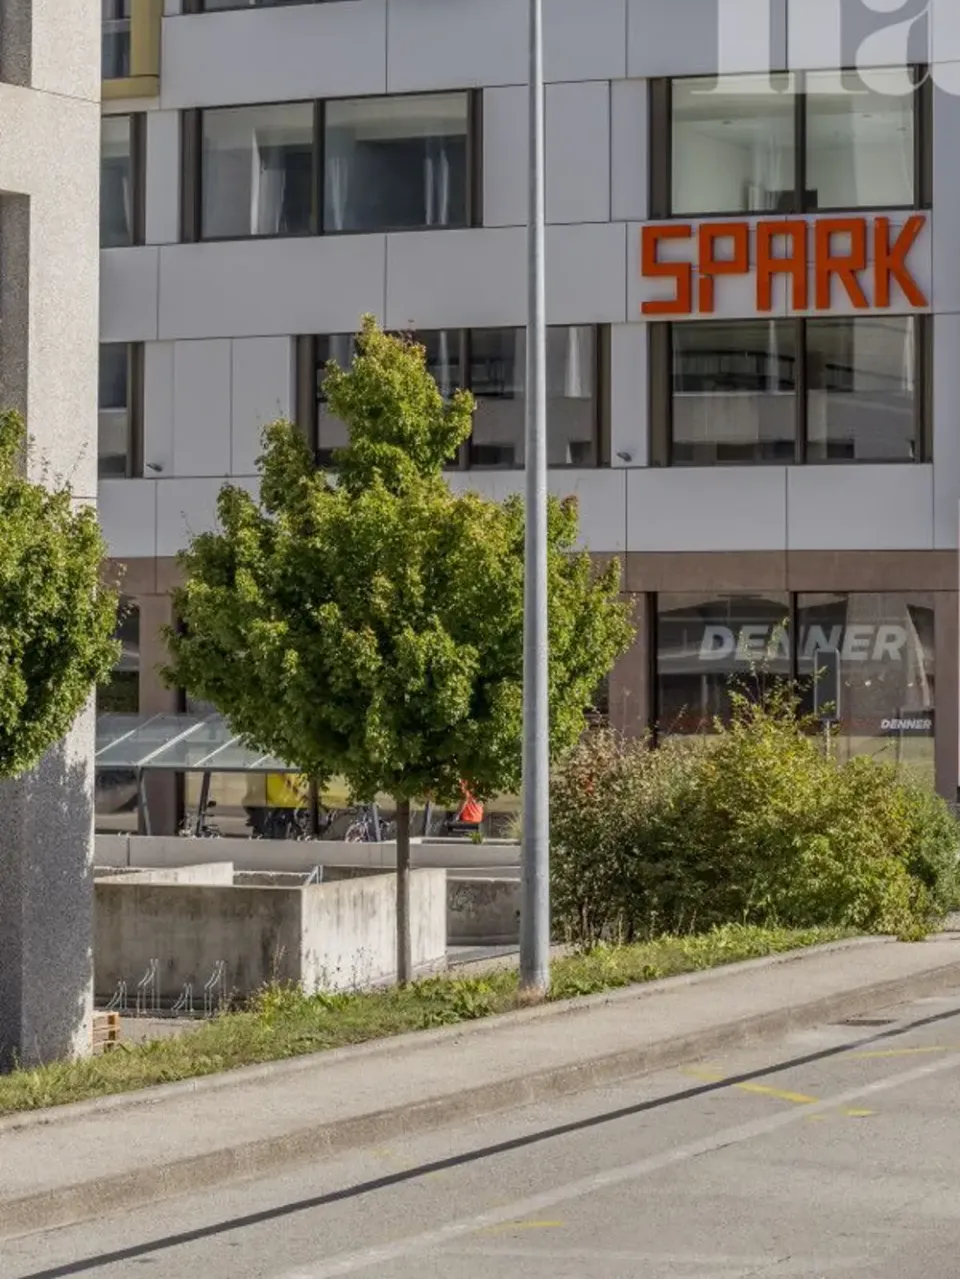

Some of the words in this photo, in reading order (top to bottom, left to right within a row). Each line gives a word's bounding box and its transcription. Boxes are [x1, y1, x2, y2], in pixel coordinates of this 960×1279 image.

[641, 215, 929, 314] SPARK
[699, 625, 907, 661] DENNER
[881, 719, 932, 730] DENNER
